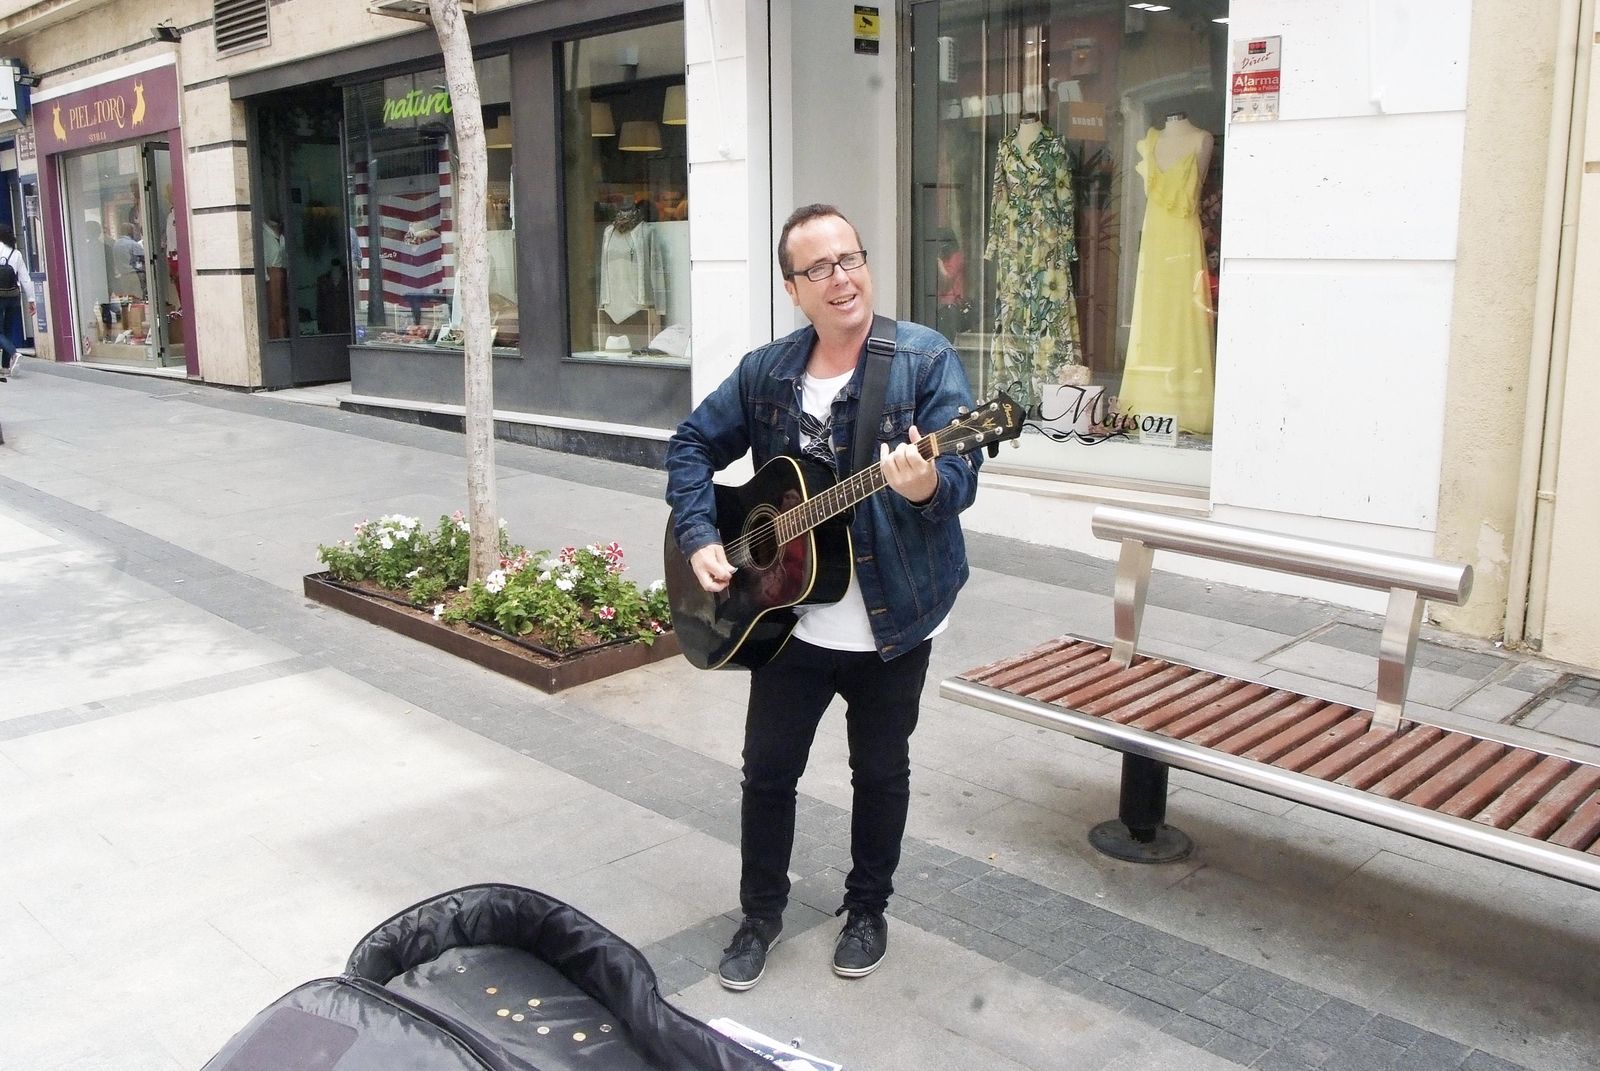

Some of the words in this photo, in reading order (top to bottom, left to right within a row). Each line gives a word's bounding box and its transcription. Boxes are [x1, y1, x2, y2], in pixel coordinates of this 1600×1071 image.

[1234, 75, 1280, 87] Alarma
[70, 105, 91, 130] PIEL
[94, 95, 125, 129] TORO
[383, 89, 453, 123] natura
